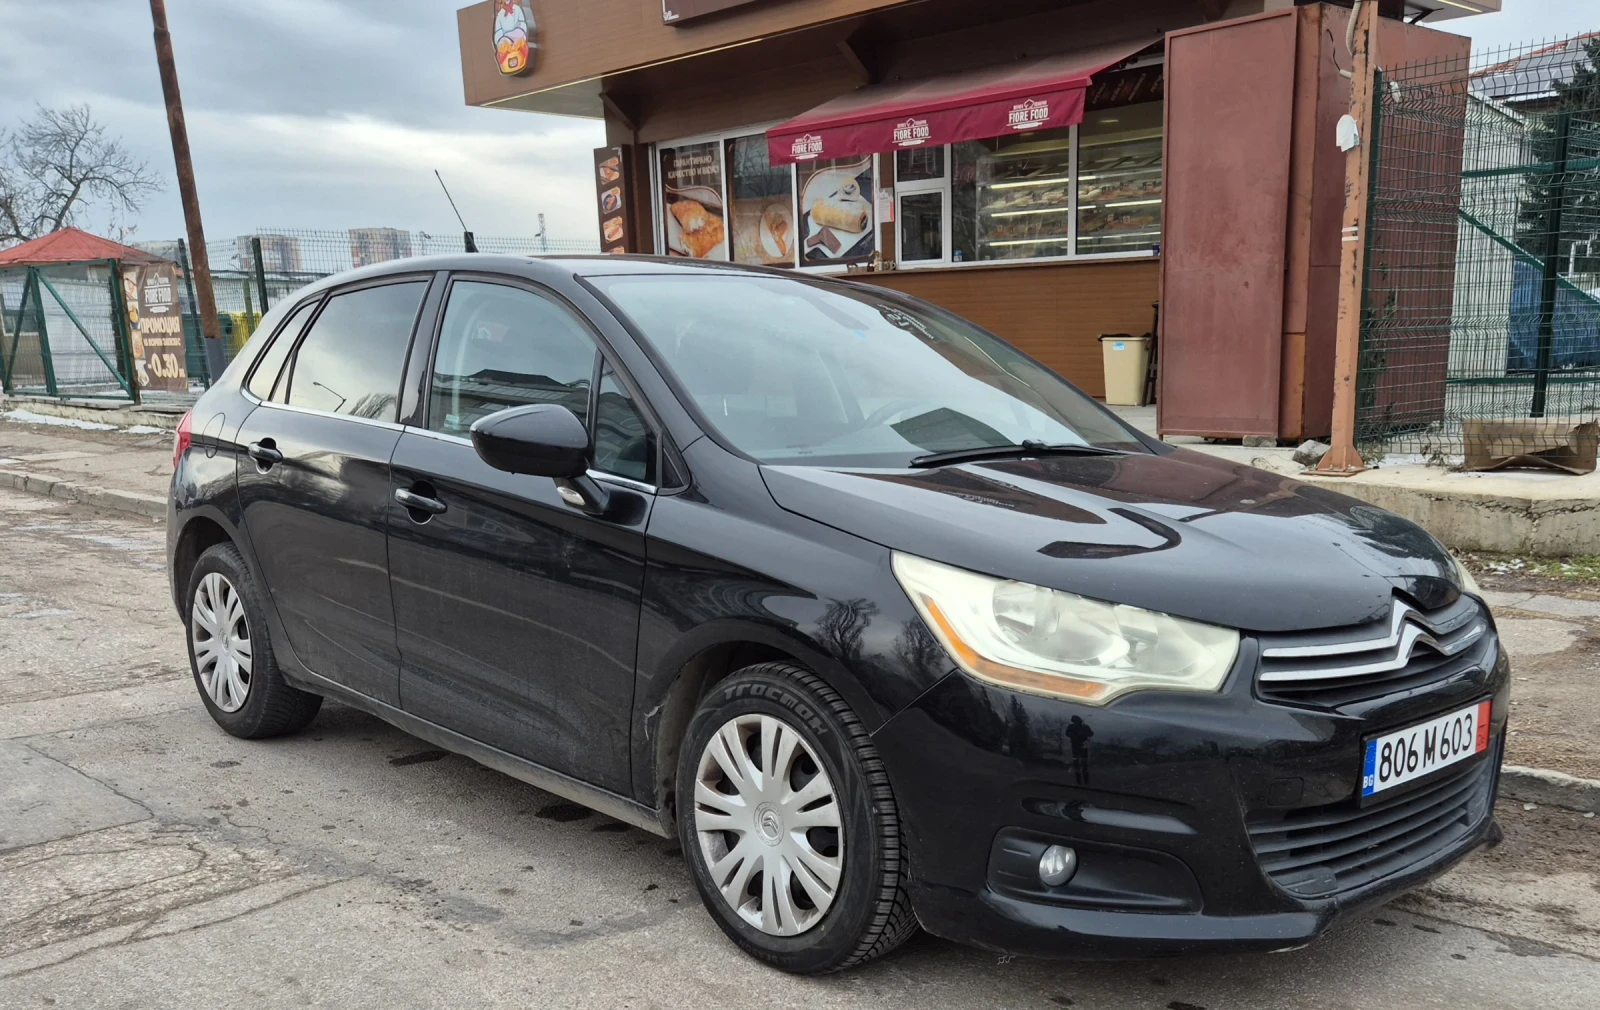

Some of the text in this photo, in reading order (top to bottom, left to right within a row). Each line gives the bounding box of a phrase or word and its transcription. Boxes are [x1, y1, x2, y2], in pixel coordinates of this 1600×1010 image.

[1009, 108, 1049, 123] FIORE FOOD
[893, 126, 929, 141] FIORE FOOD
[791, 141, 822, 155] FIORE FOOD
[140, 316, 180, 336] ПРОМОЦИЯ
[1363, 774, 1374, 788] BG
